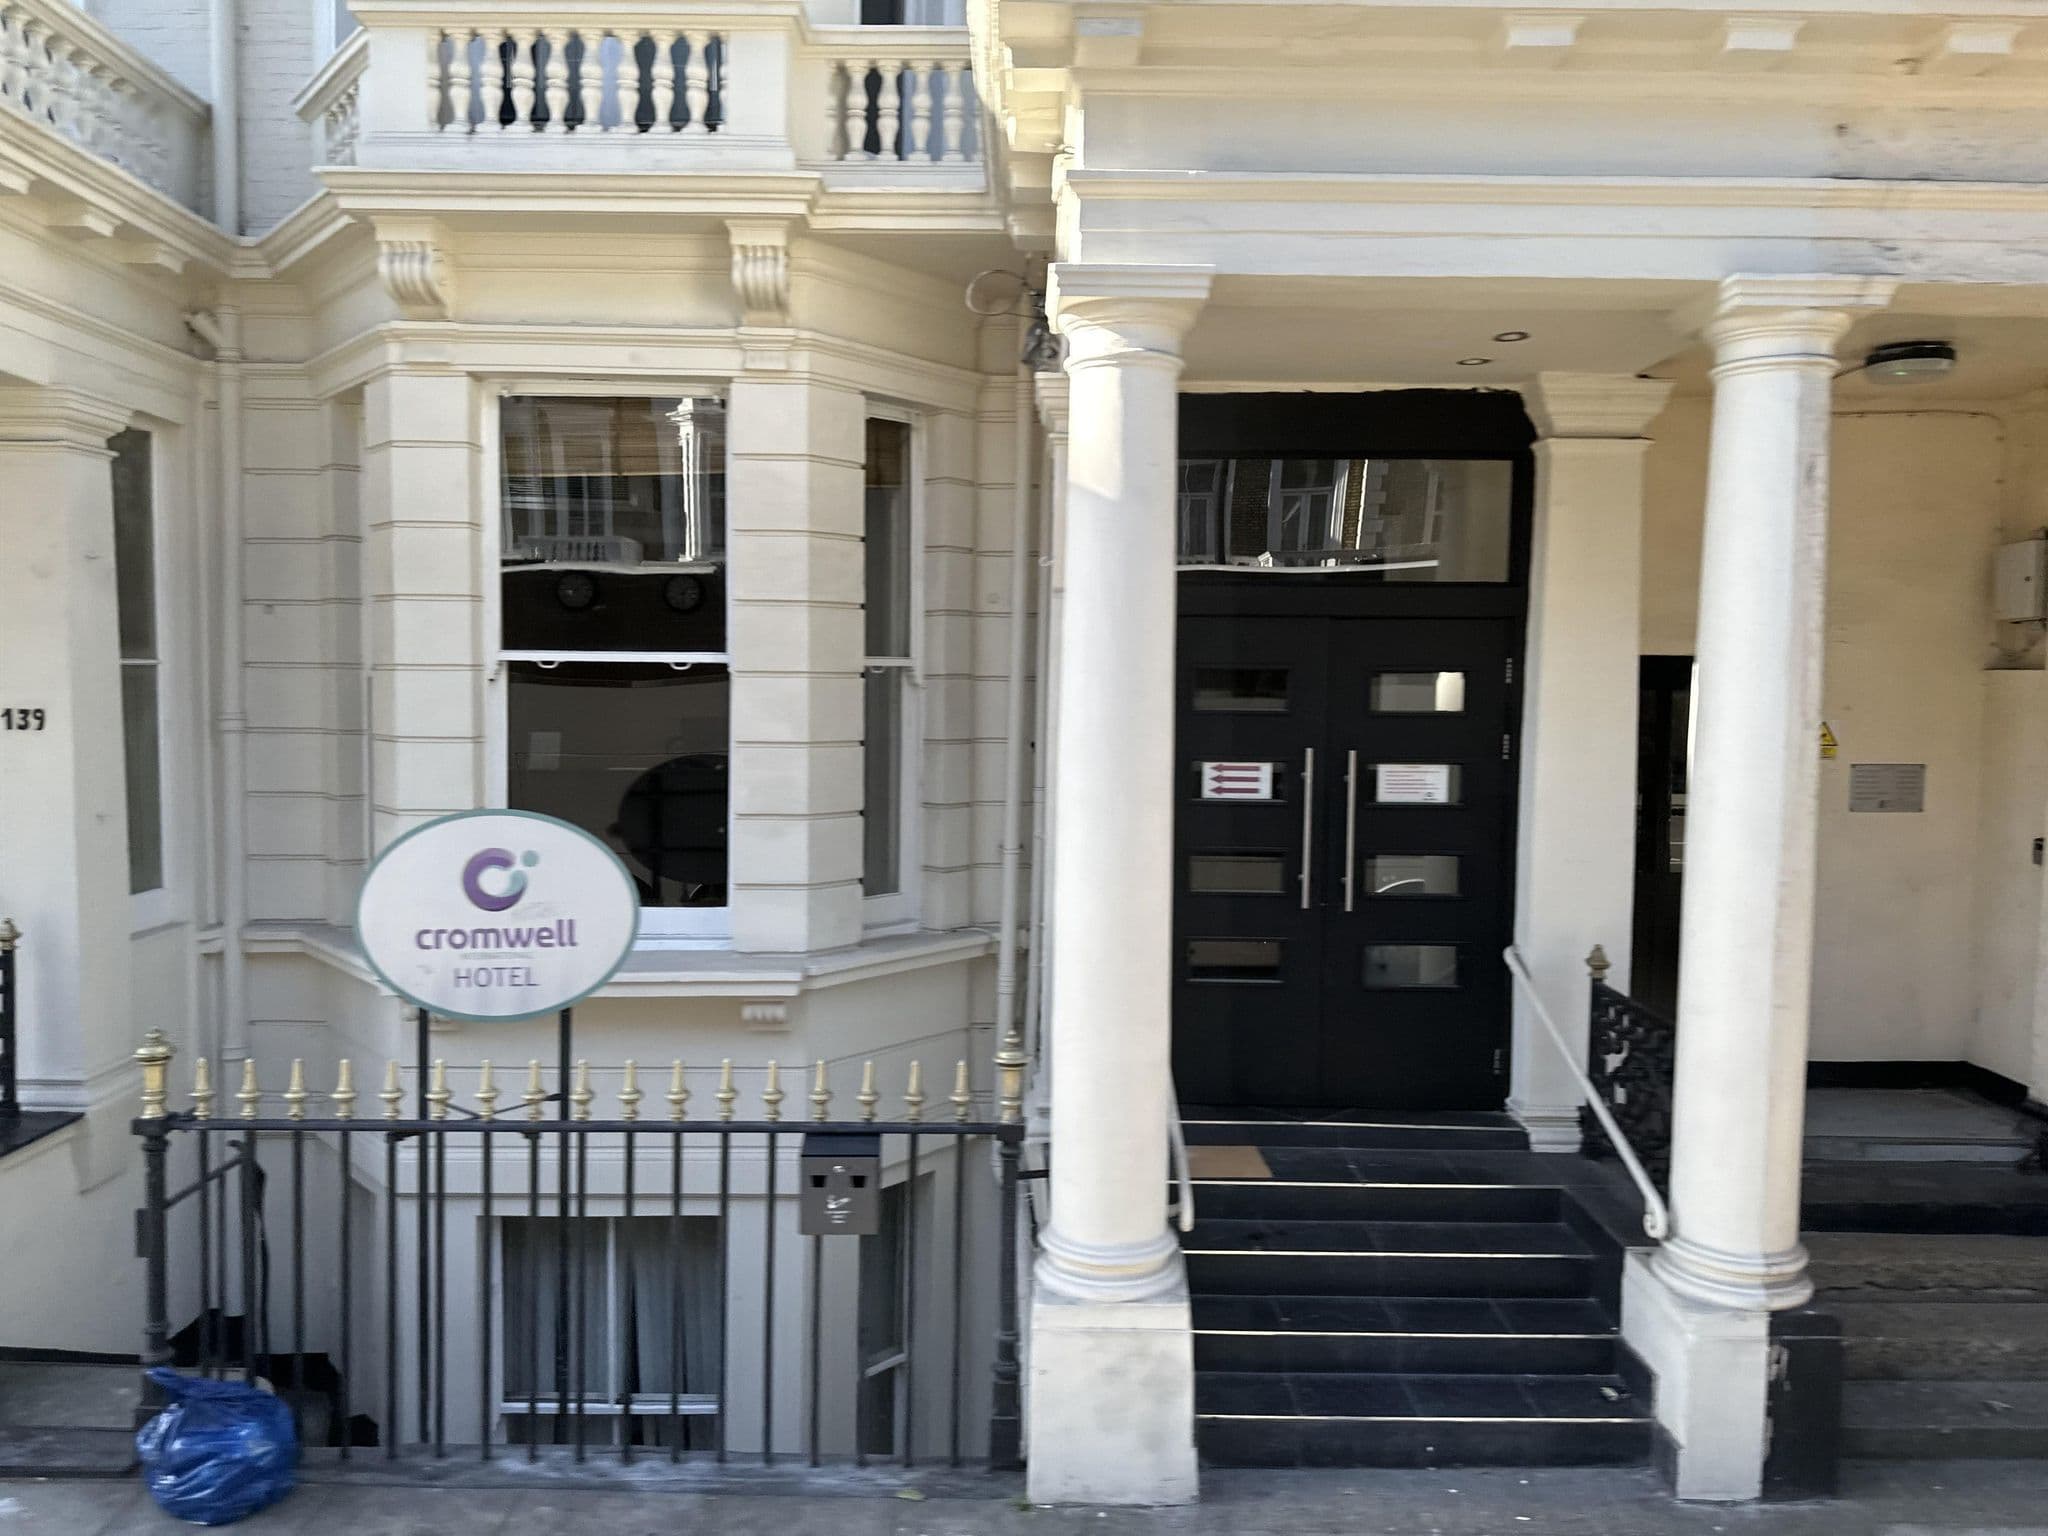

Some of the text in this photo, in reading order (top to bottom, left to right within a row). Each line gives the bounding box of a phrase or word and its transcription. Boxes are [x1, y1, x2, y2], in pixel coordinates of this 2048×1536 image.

[1, 707, 46, 731] 139
[416, 919, 577, 950] cromwell
[453, 966, 540, 988] HOTEL
